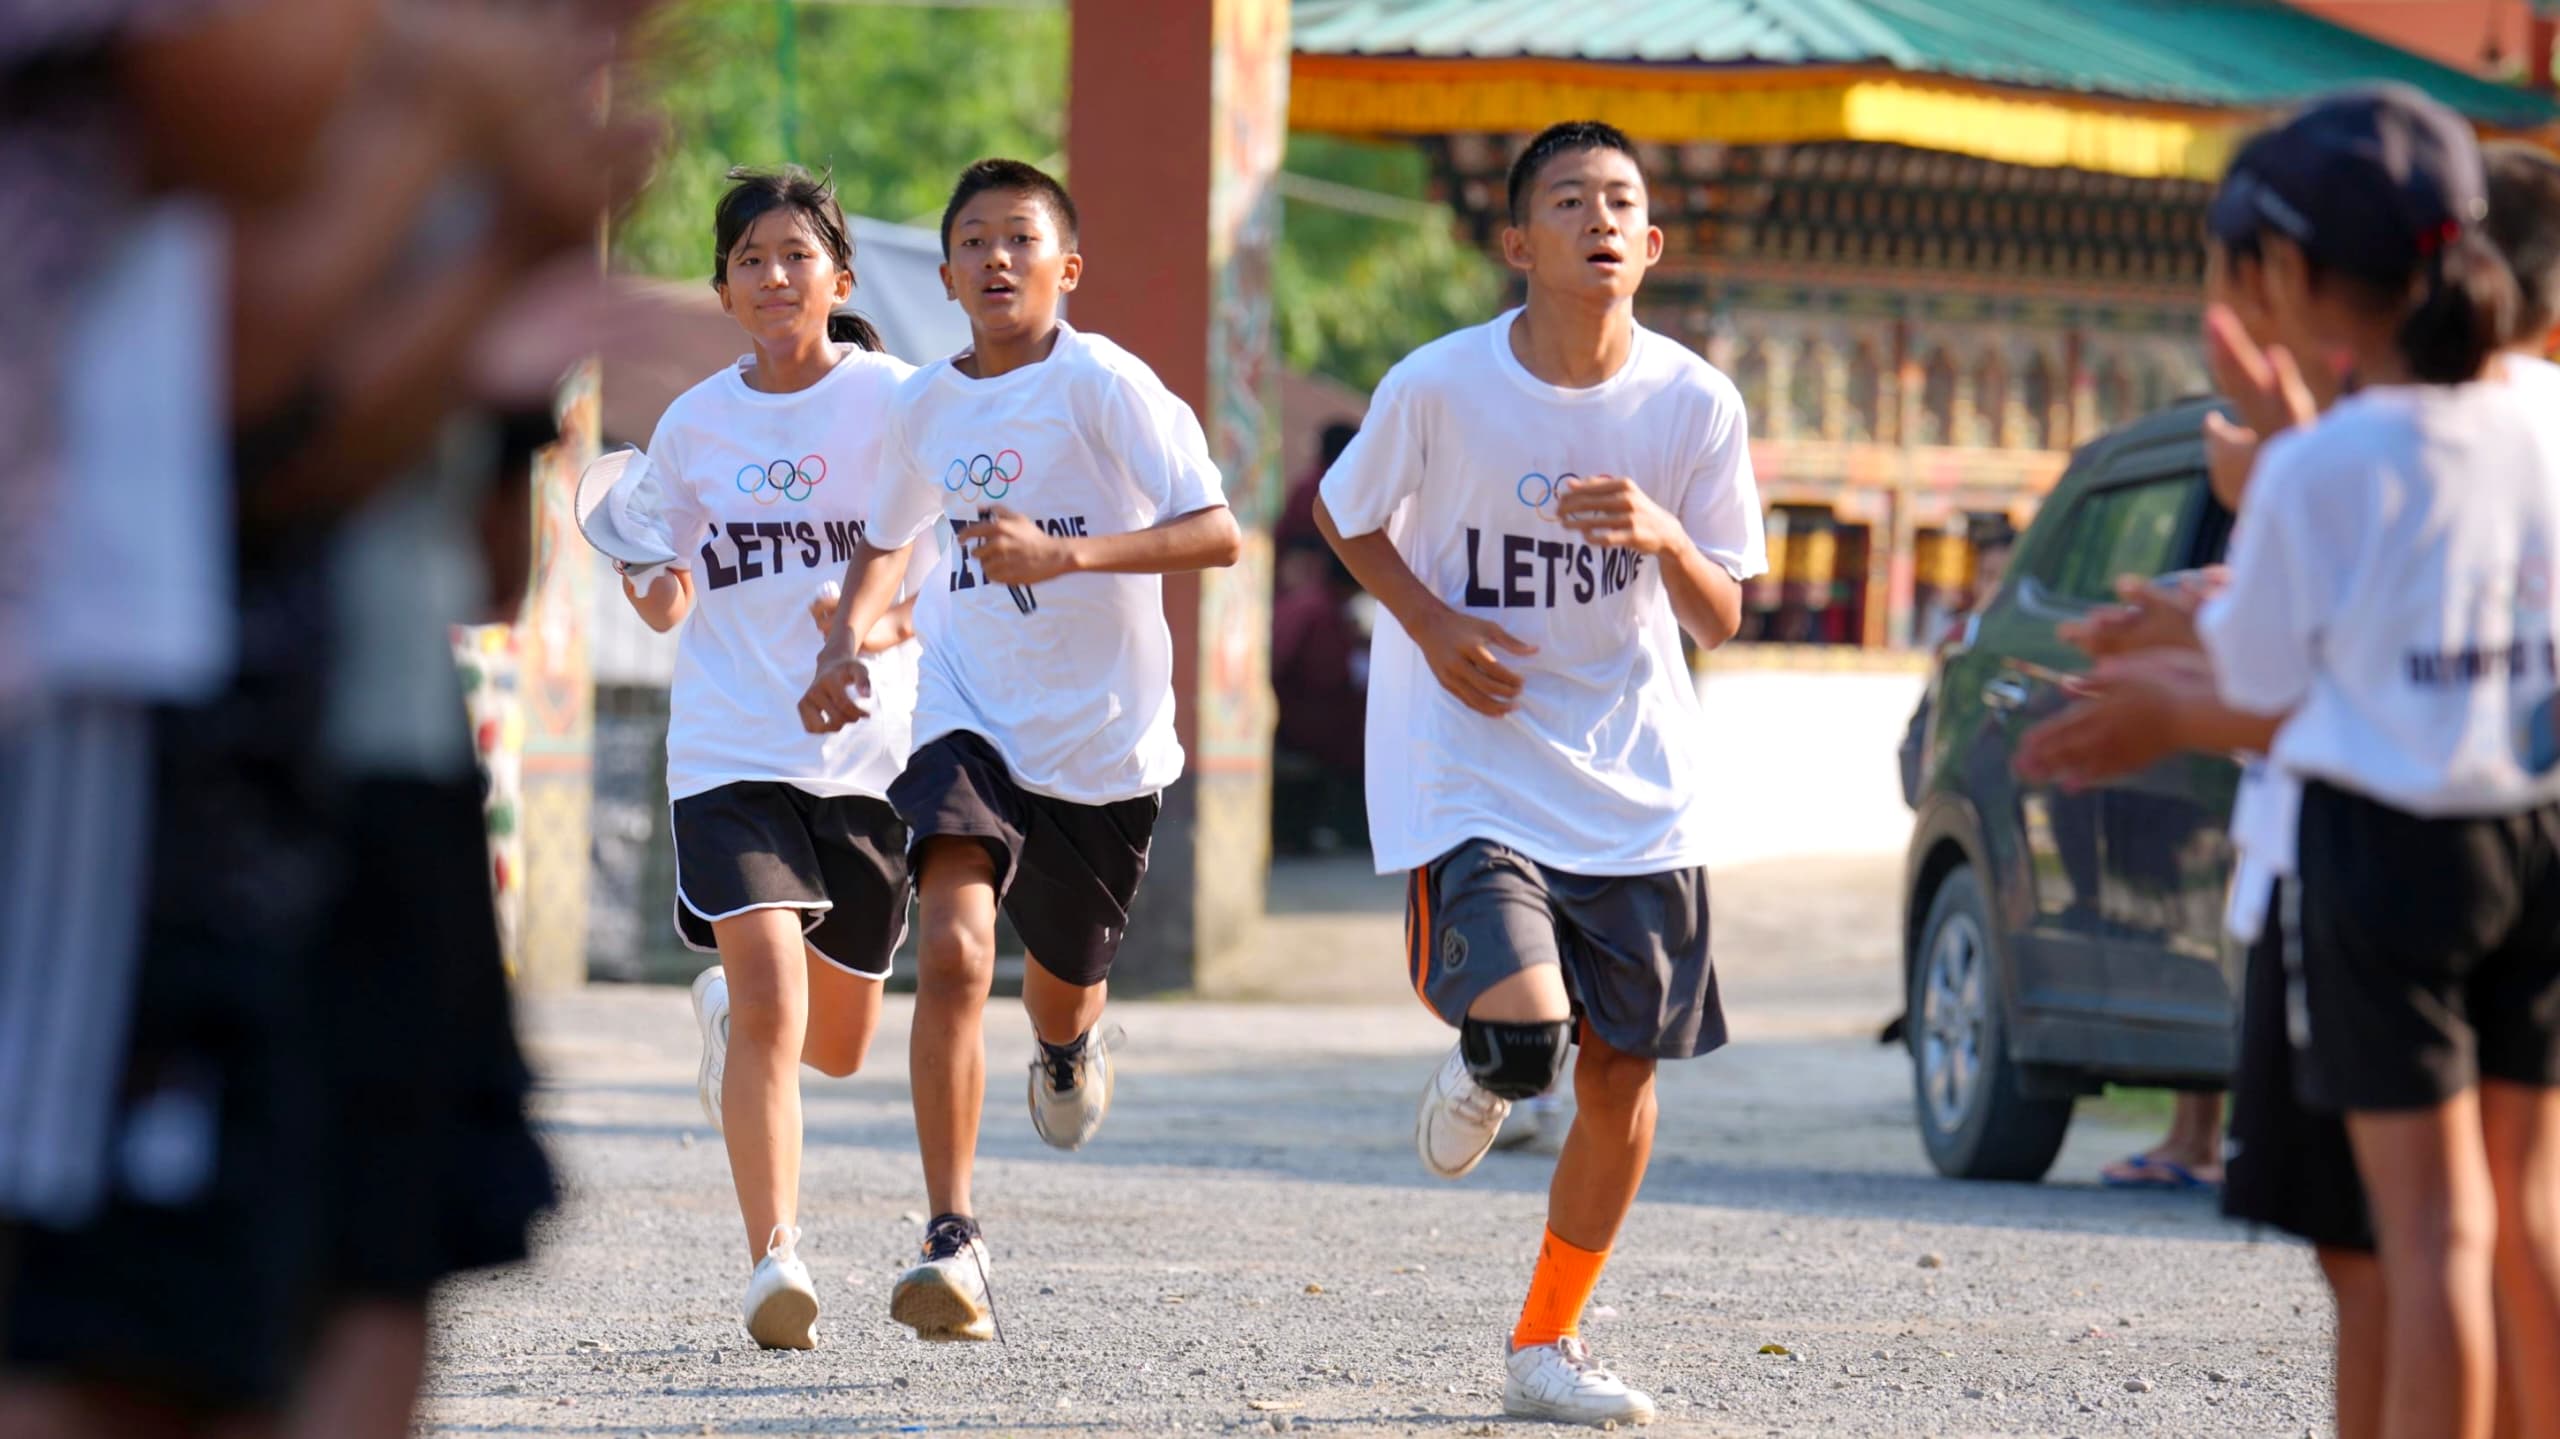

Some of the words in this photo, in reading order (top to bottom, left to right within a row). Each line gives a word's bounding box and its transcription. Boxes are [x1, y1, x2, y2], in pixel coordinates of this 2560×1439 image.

[701, 521, 821, 590] LET'S
[824, 520, 865, 562] MO
[1465, 528, 1594, 608] LET'S
